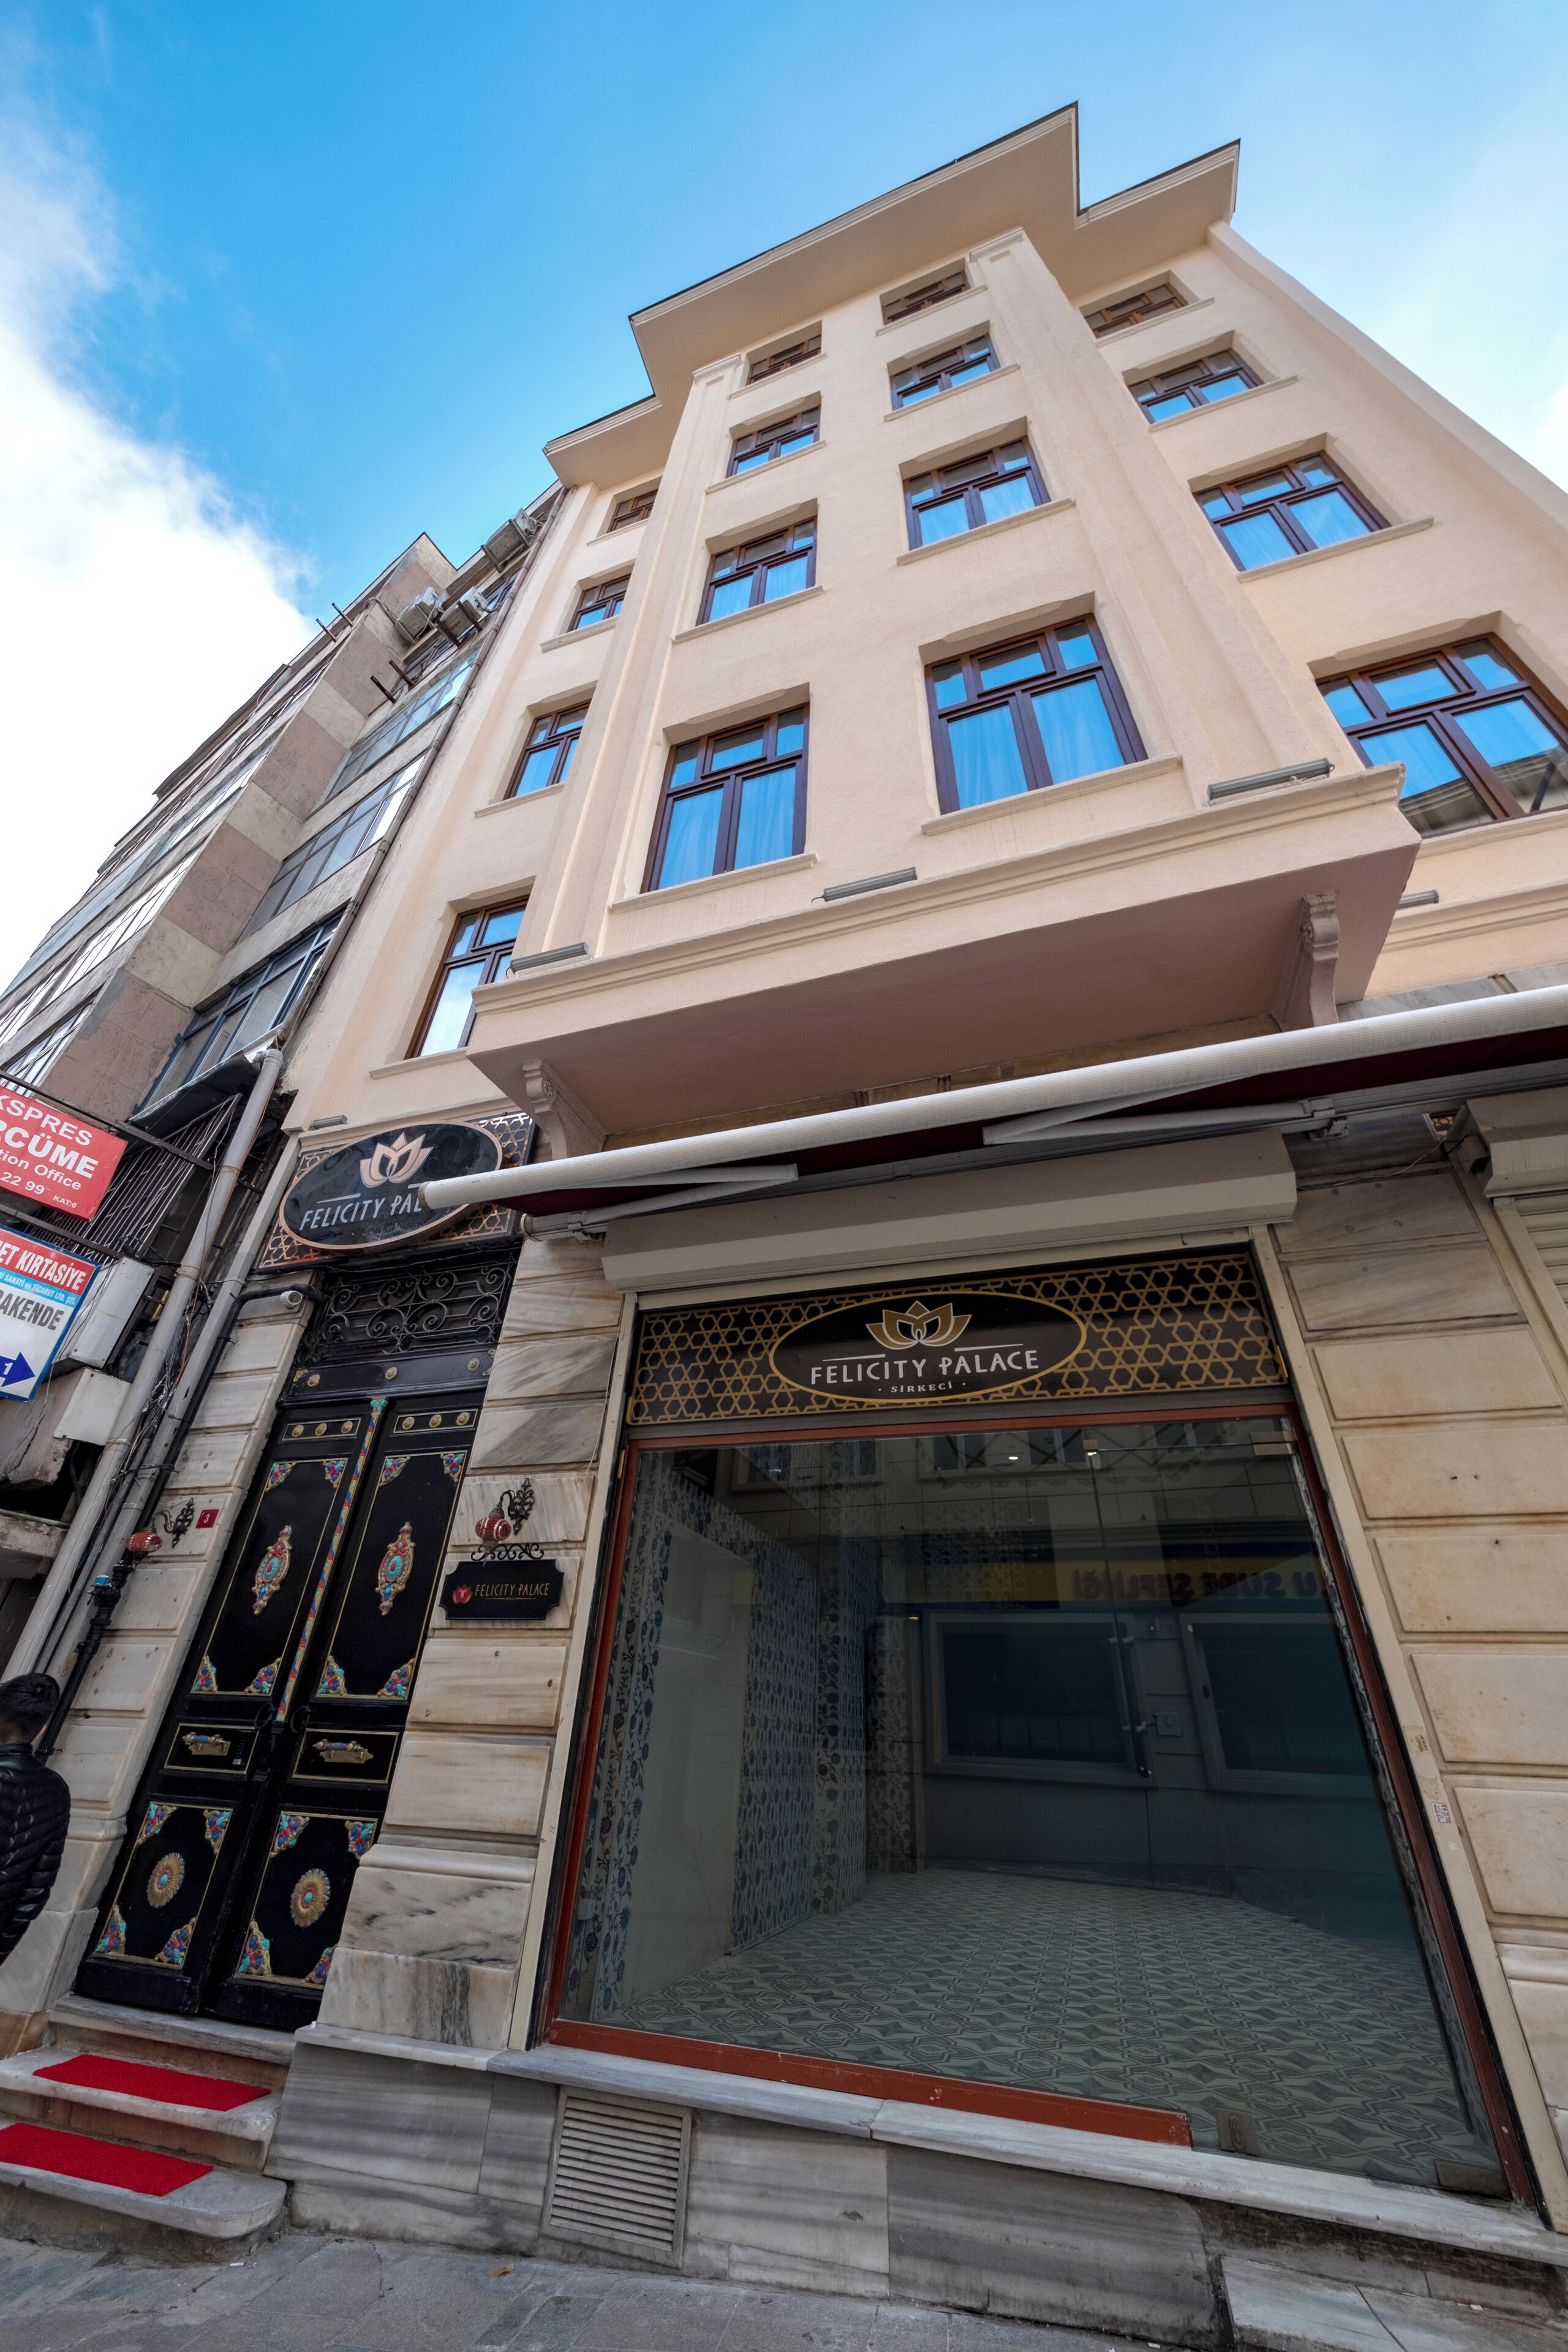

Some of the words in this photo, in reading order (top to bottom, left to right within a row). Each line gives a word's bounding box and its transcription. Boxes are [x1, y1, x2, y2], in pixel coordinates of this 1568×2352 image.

[0, 1172, 22, 1186] 22
[24, 1181, 45, 1194] 99
[34, 1164, 81, 1190] Office
[53, 1195, 77, 1208] KAT:6
[300, 1196, 386, 1231] FELICITY
[390, 1193, 422, 1216] PAL
[15, 1250, 86, 1291] KIRTASİYE
[4, 1273, 26, 1286] SANAYİ
[32, 1283, 55, 1297] TİCARET
[54, 1292, 65, 1302] LTD.
[811, 1359, 927, 1385] FELICITY
[938, 1350, 1039, 1376] PALACE
[890, 1380, 953, 1393] SİRKECİ
[203, 1513, 211, 1523] 3
[475, 1583, 516, 1597] FELICITY
[518, 1583, 550, 1596] PALACE
